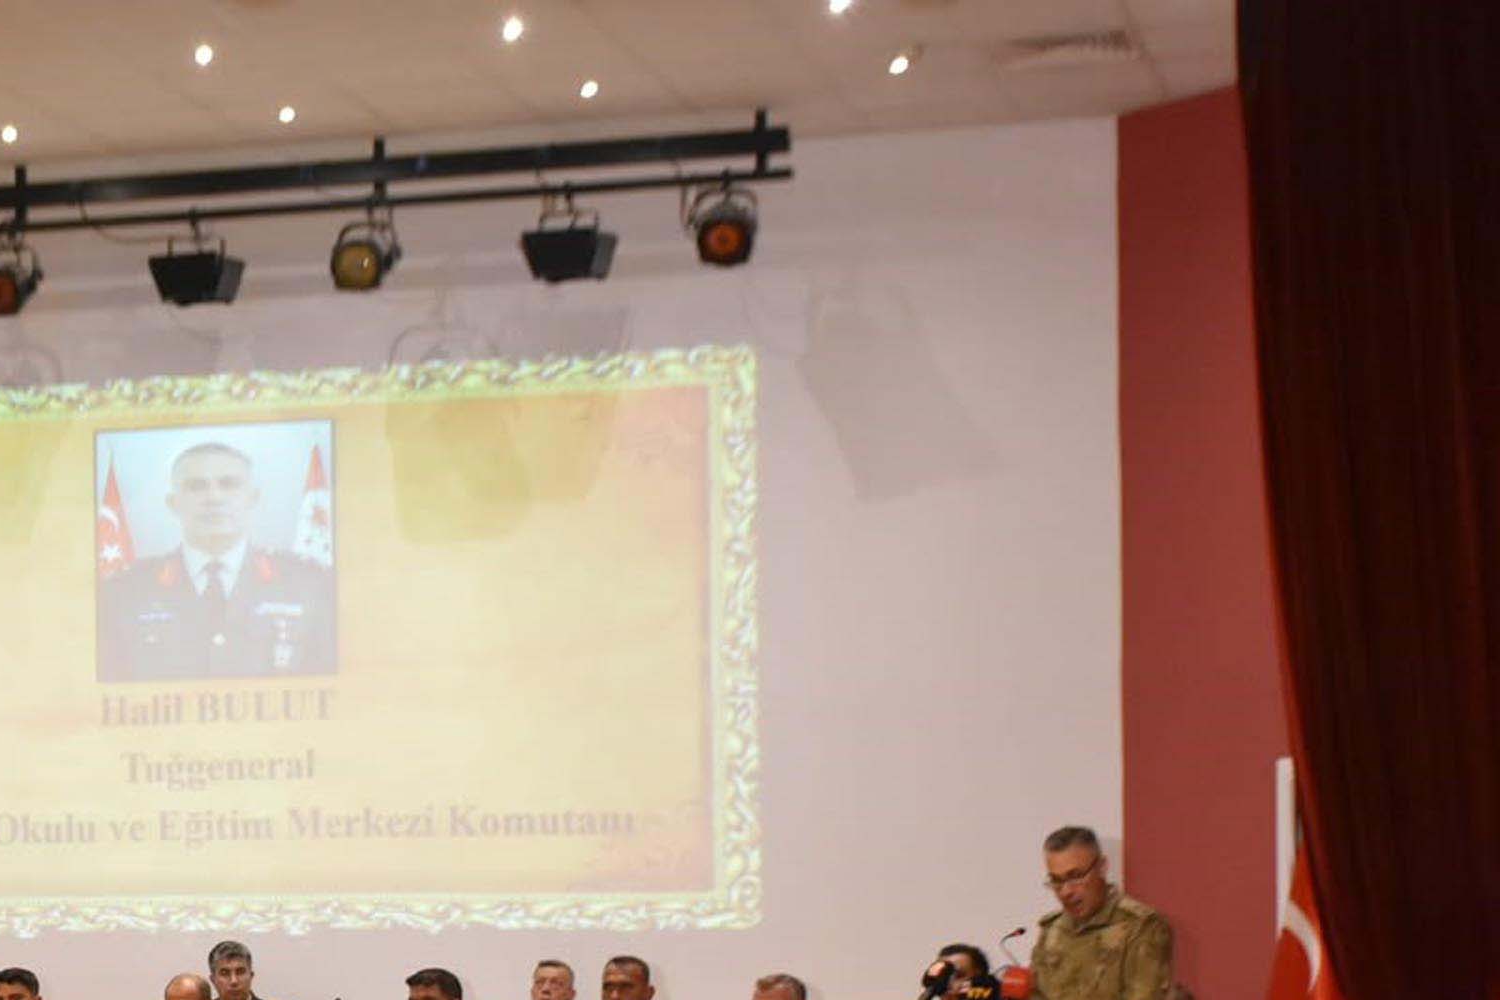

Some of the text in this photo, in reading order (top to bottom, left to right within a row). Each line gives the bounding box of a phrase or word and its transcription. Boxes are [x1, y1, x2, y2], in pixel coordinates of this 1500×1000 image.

[100, 687, 334, 727] Halil BULUT
[120, 748, 315, 790] Tuğgeneral
[108, 816, 147, 842] ve
[157, 806, 274, 852] Eğitim
[288, 803, 434, 842] Merkezi
